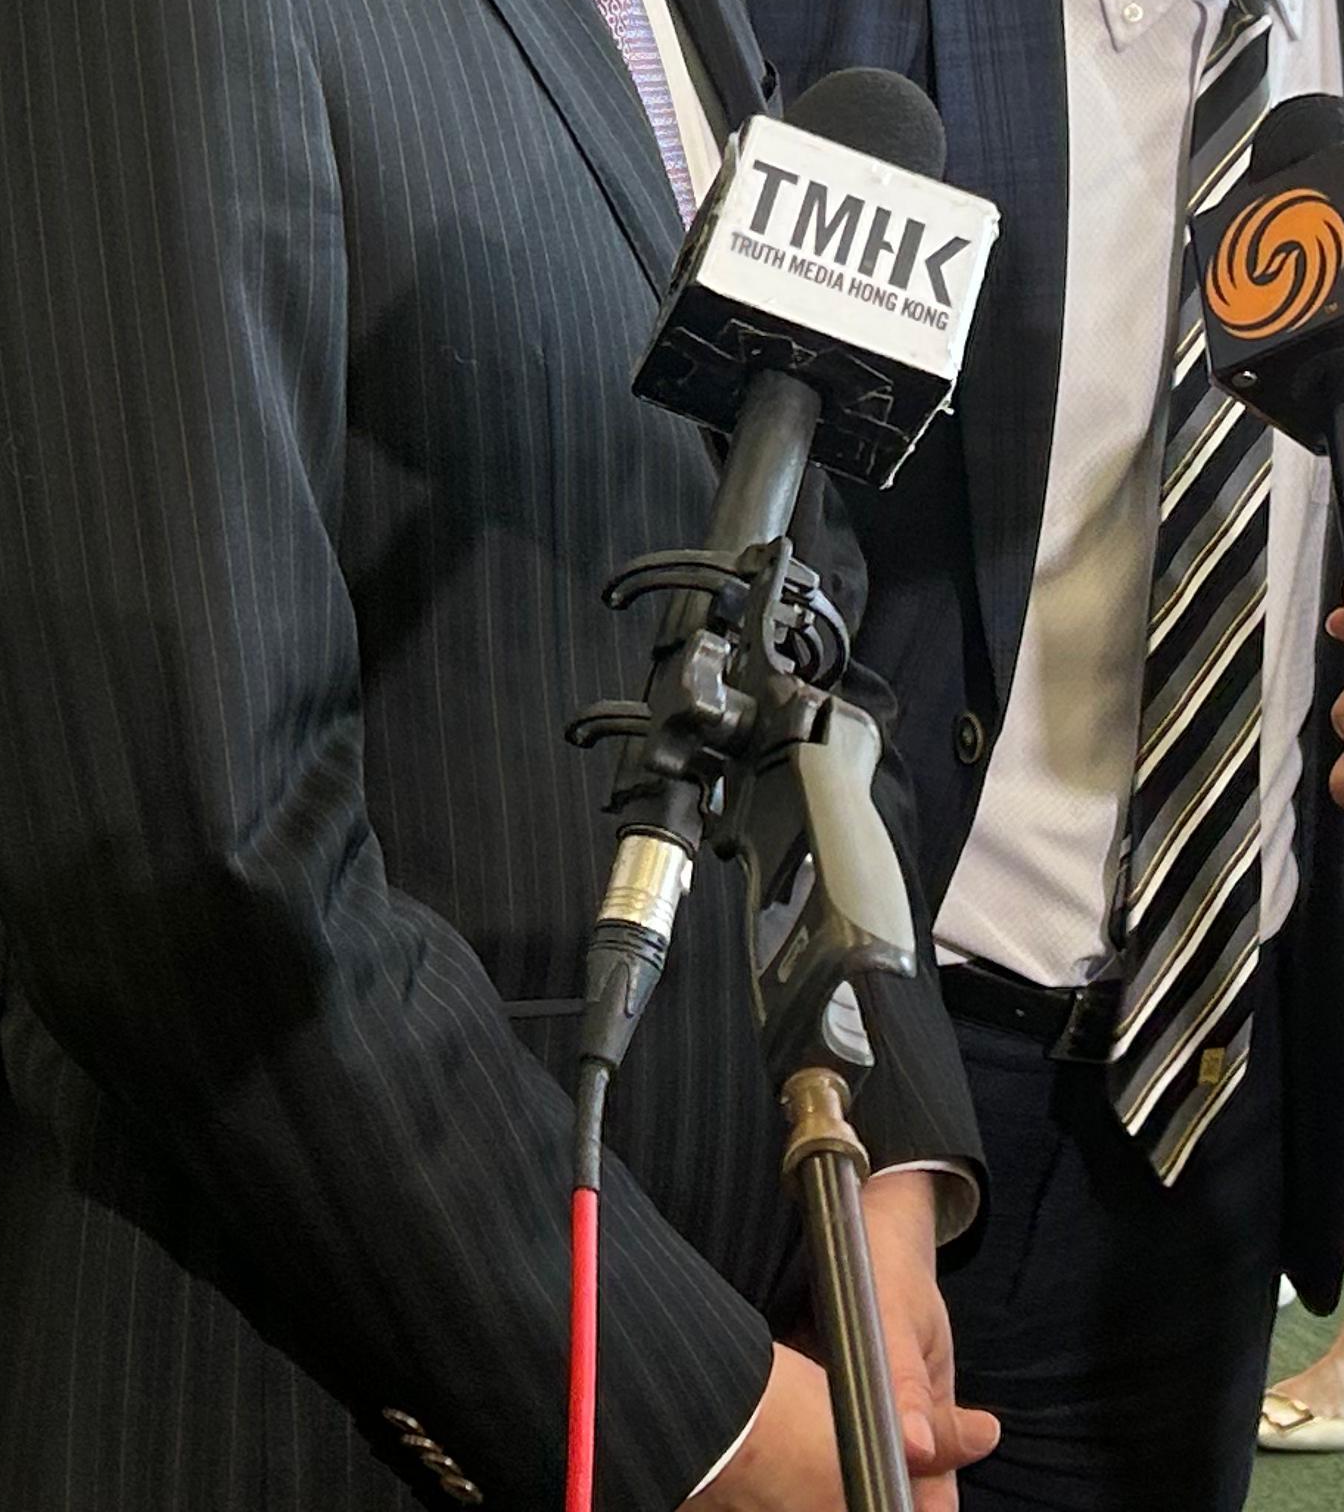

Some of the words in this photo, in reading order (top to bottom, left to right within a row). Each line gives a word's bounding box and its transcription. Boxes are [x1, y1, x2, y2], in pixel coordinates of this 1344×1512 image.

[729, 231, 787, 269] TRUTH
[787, 255, 844, 292] MEDIA
[847, 277, 899, 312] HONG
[900, 298, 951, 331] KONG
[748, 159, 972, 308] TMHK
